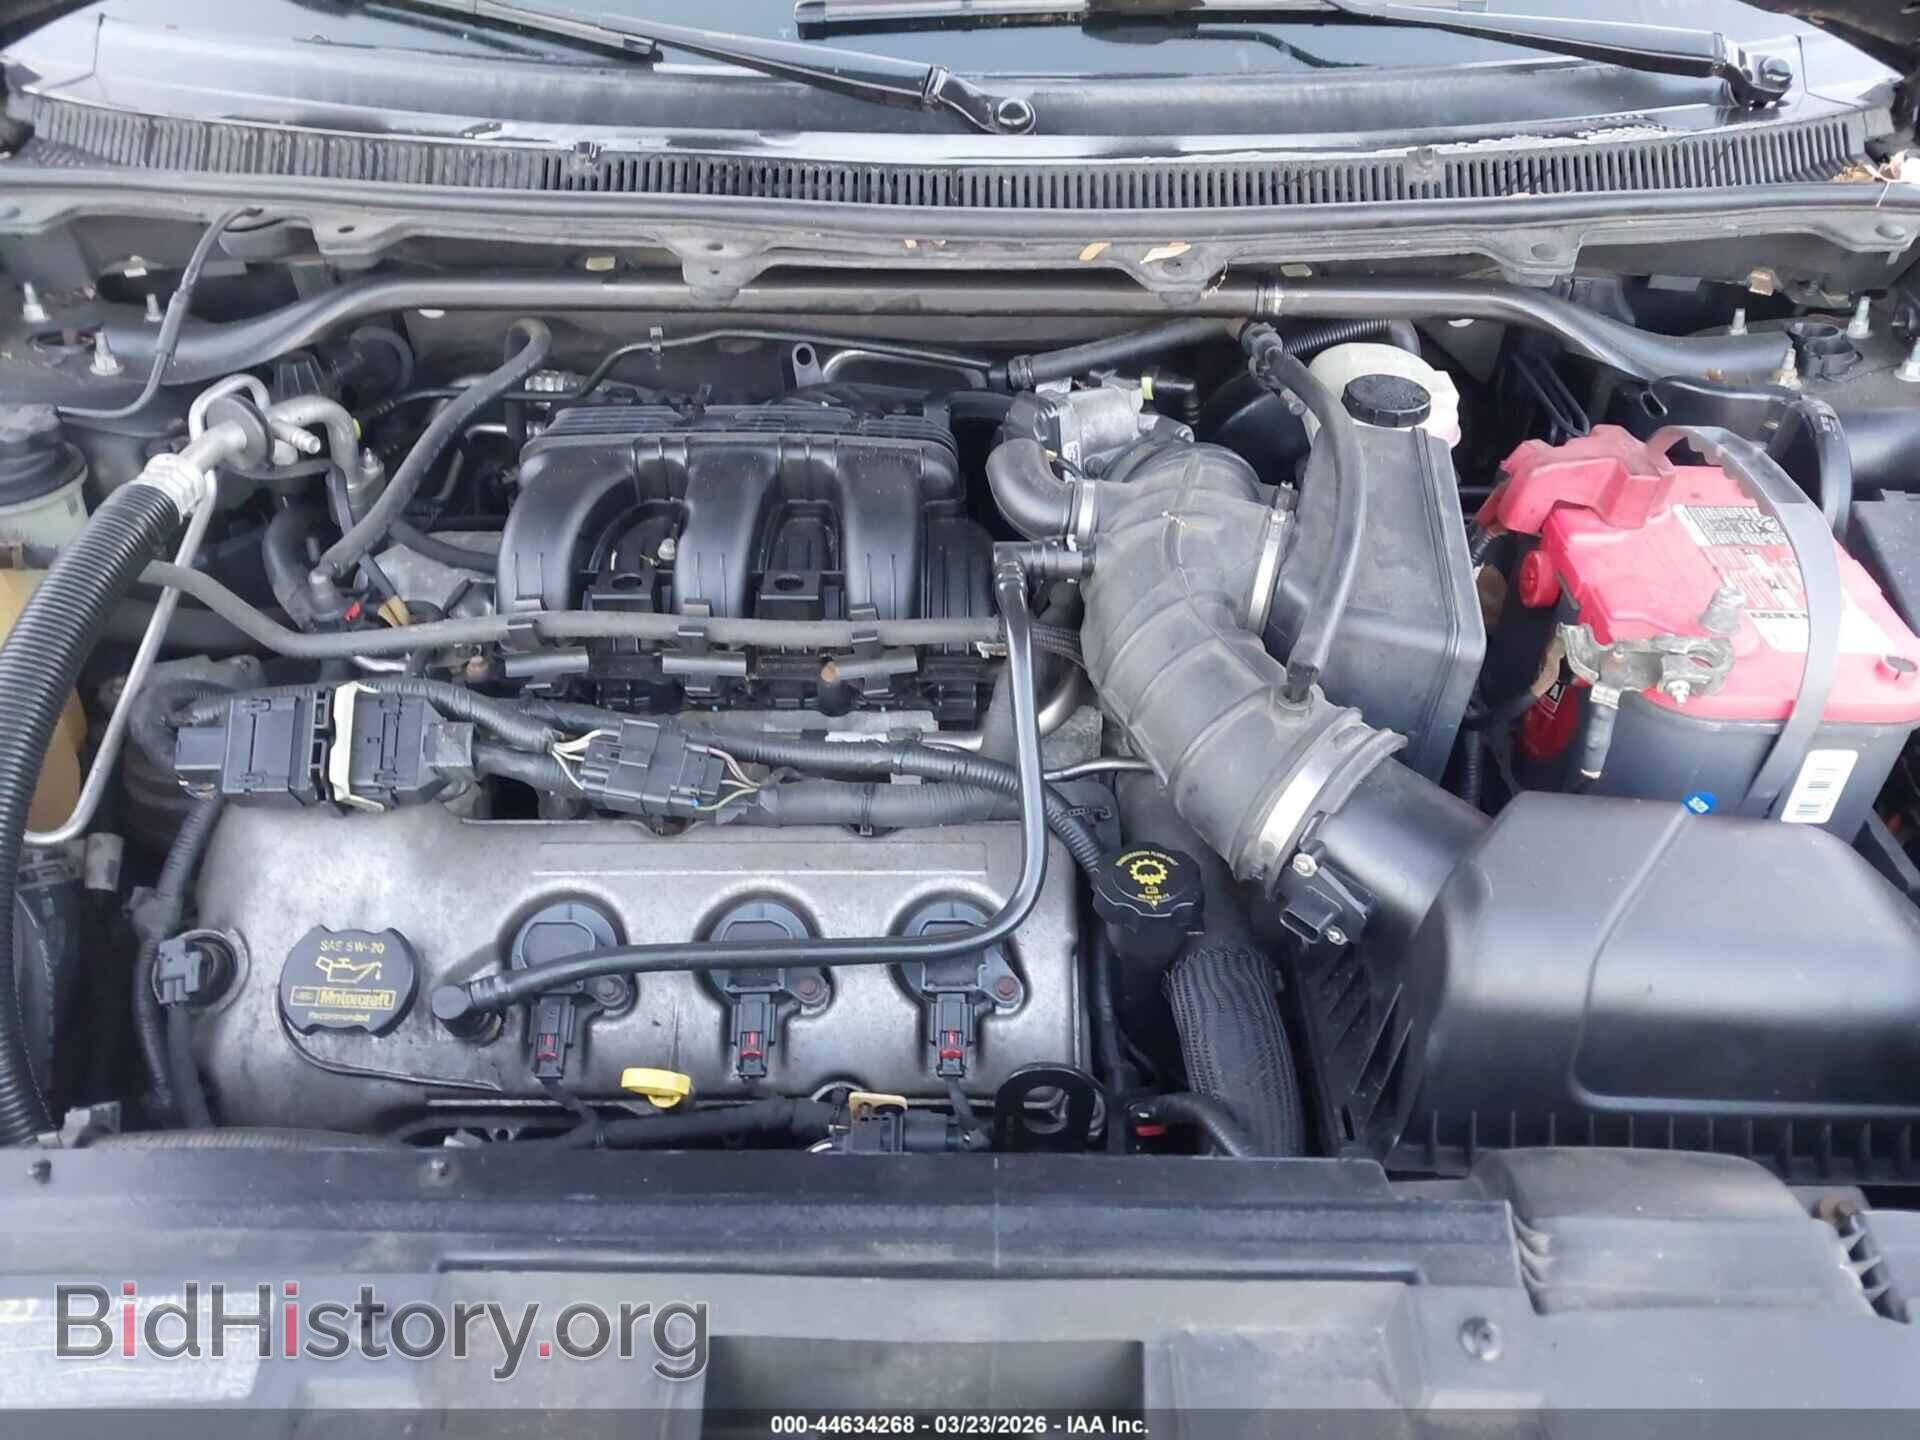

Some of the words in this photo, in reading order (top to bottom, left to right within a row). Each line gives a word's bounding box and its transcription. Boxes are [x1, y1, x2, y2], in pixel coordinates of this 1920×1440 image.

[320, 940, 342, 952] SAE
[346, 941, 385, 954] 5W-20
[320, 991, 391, 1008] Motorcraft
